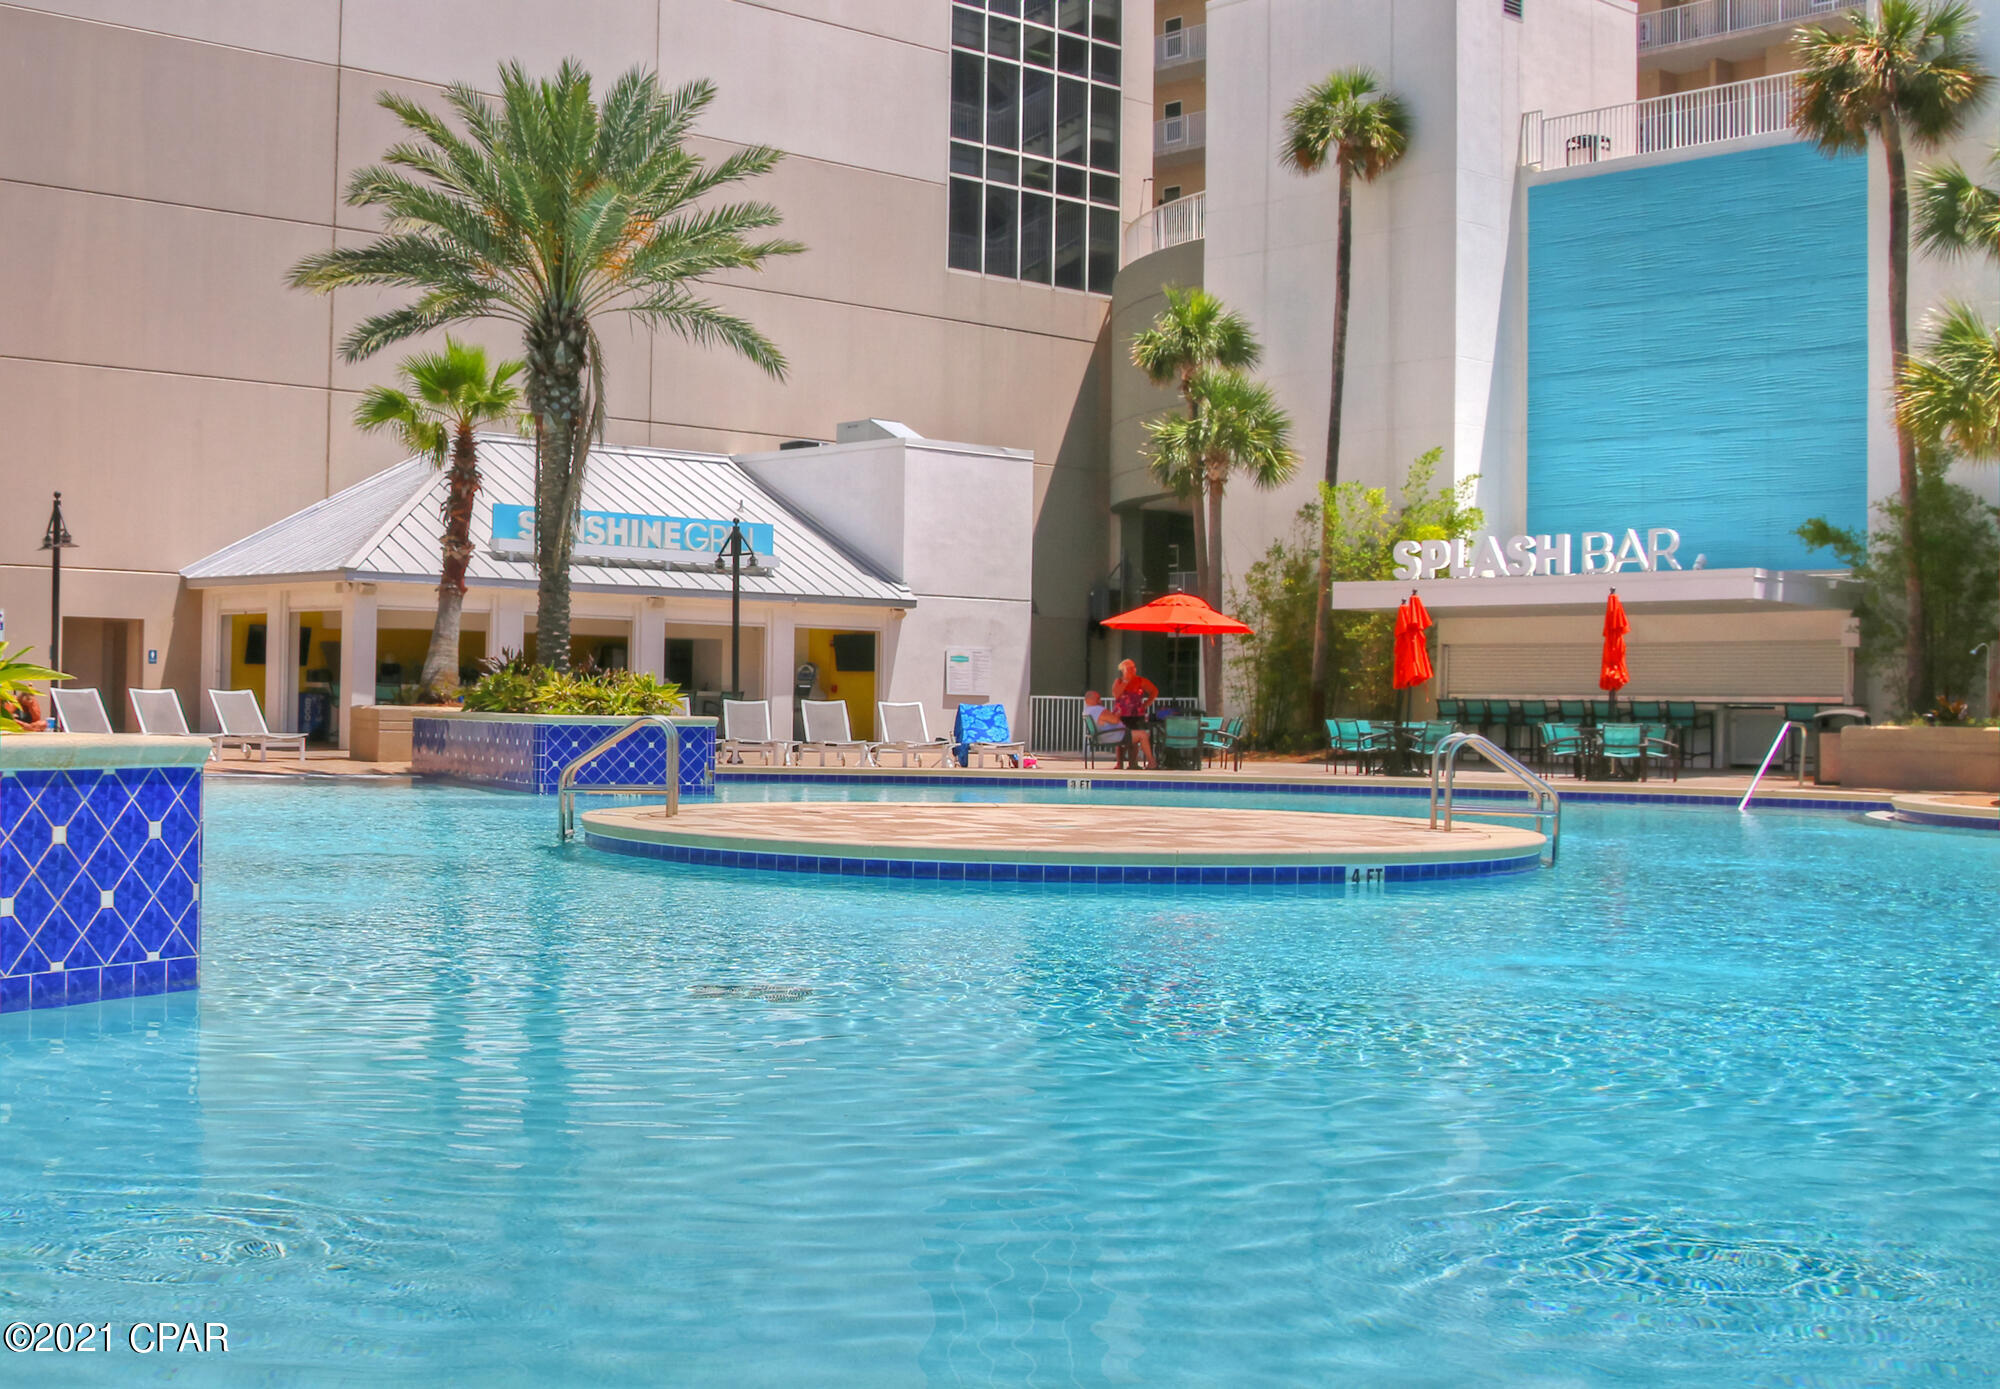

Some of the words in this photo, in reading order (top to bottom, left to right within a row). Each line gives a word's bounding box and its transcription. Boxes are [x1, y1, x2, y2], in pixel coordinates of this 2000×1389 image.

[518, 510, 681, 549] SNSHINE
[1392, 533, 1572, 581] SPLASH
[1581, 527, 1682, 574] BAR
[1080, 780, 1090, 790] FT
[1351, 868, 1361, 883] 4
[1366, 868, 1384, 883] FT
